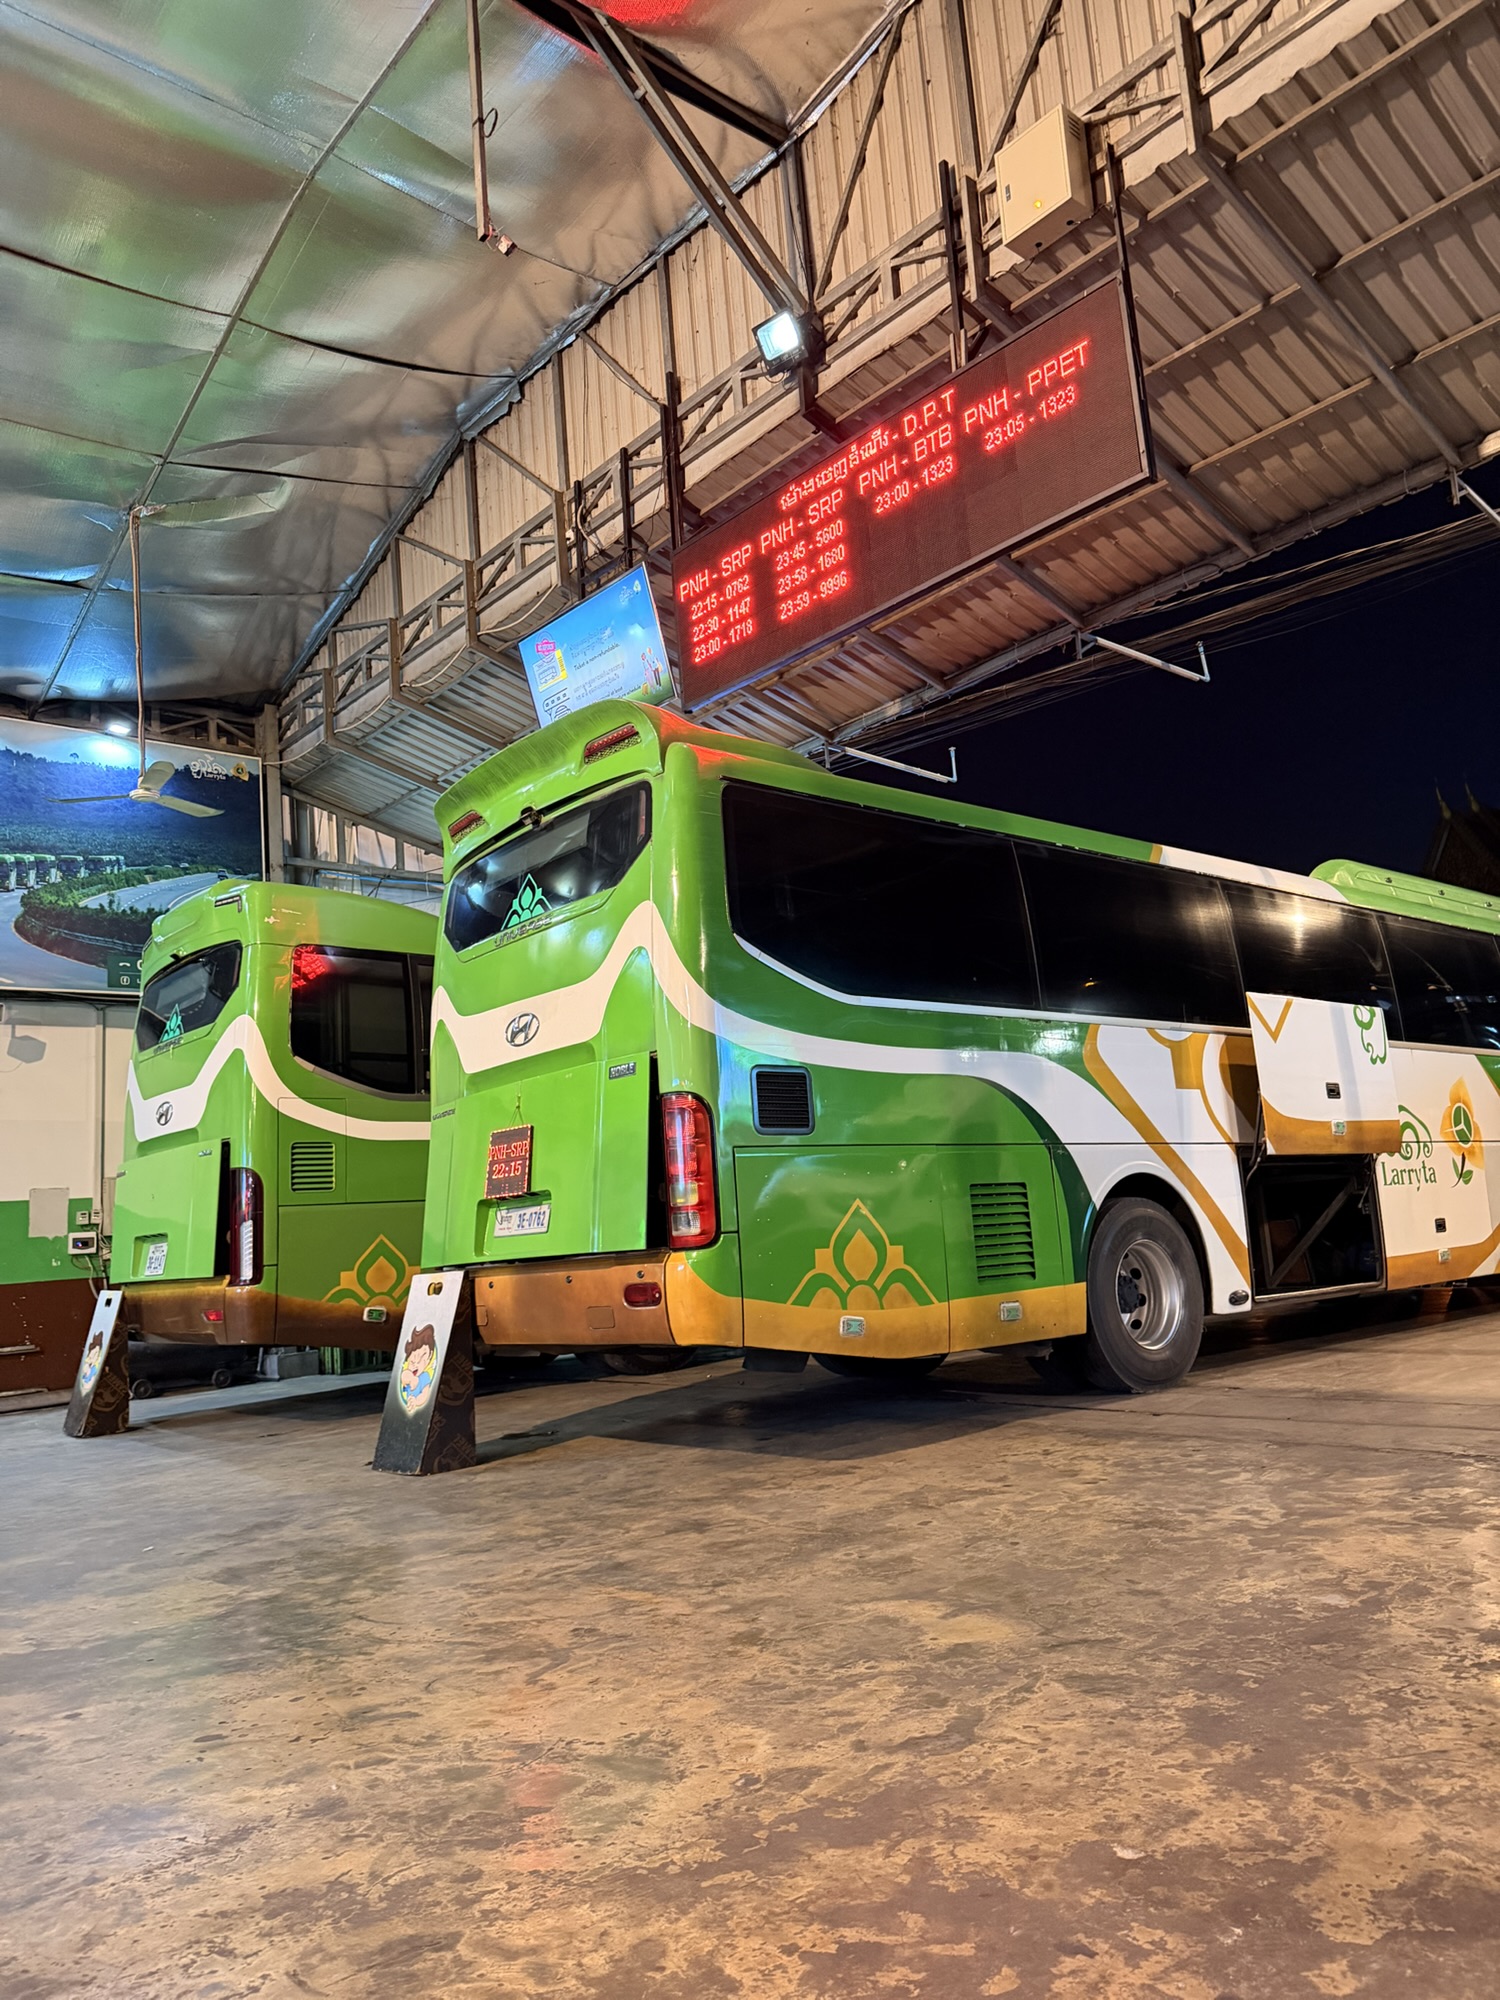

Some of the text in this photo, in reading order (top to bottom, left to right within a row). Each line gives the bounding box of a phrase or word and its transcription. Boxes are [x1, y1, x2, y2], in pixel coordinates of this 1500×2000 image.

[964, 388, 1008, 433] PNH
[1028, 341, 1088, 396] PPET
[985, 414, 1025, 451] 23:05
[1039, 386, 1075, 418] 1323
[858, 455, 898, 495] PNH
[914, 423, 952, 462] BTB
[875, 481, 909, 513] 23:00
[921, 455, 953, 485] 1323
[760, 518, 794, 554] PNH
[808, 488, 843, 525] SRP
[776, 541, 806, 571] 23:45
[816, 520, 843, 547] 5600
[680, 569, 709, 602] PNH
[721, 544, 751, 577] SRP
[778, 566, 808, 595] 23:58
[817, 544, 845, 571] 1680
[691, 593, 717, 620] 22:15
[725, 574, 750, 600] 0762
[693, 616, 719, 642] 22:30
[728, 597, 751, 622] 1147
[780, 591, 810, 620] 23:59
[694, 637, 720, 663] 23:00
[729, 619, 753, 643] 1718
[490, 1140, 528, 1160] PNH-SRP
[492, 1161, 522, 1178] 22:15
[1381, 1160, 1437, 1192] Larryta
